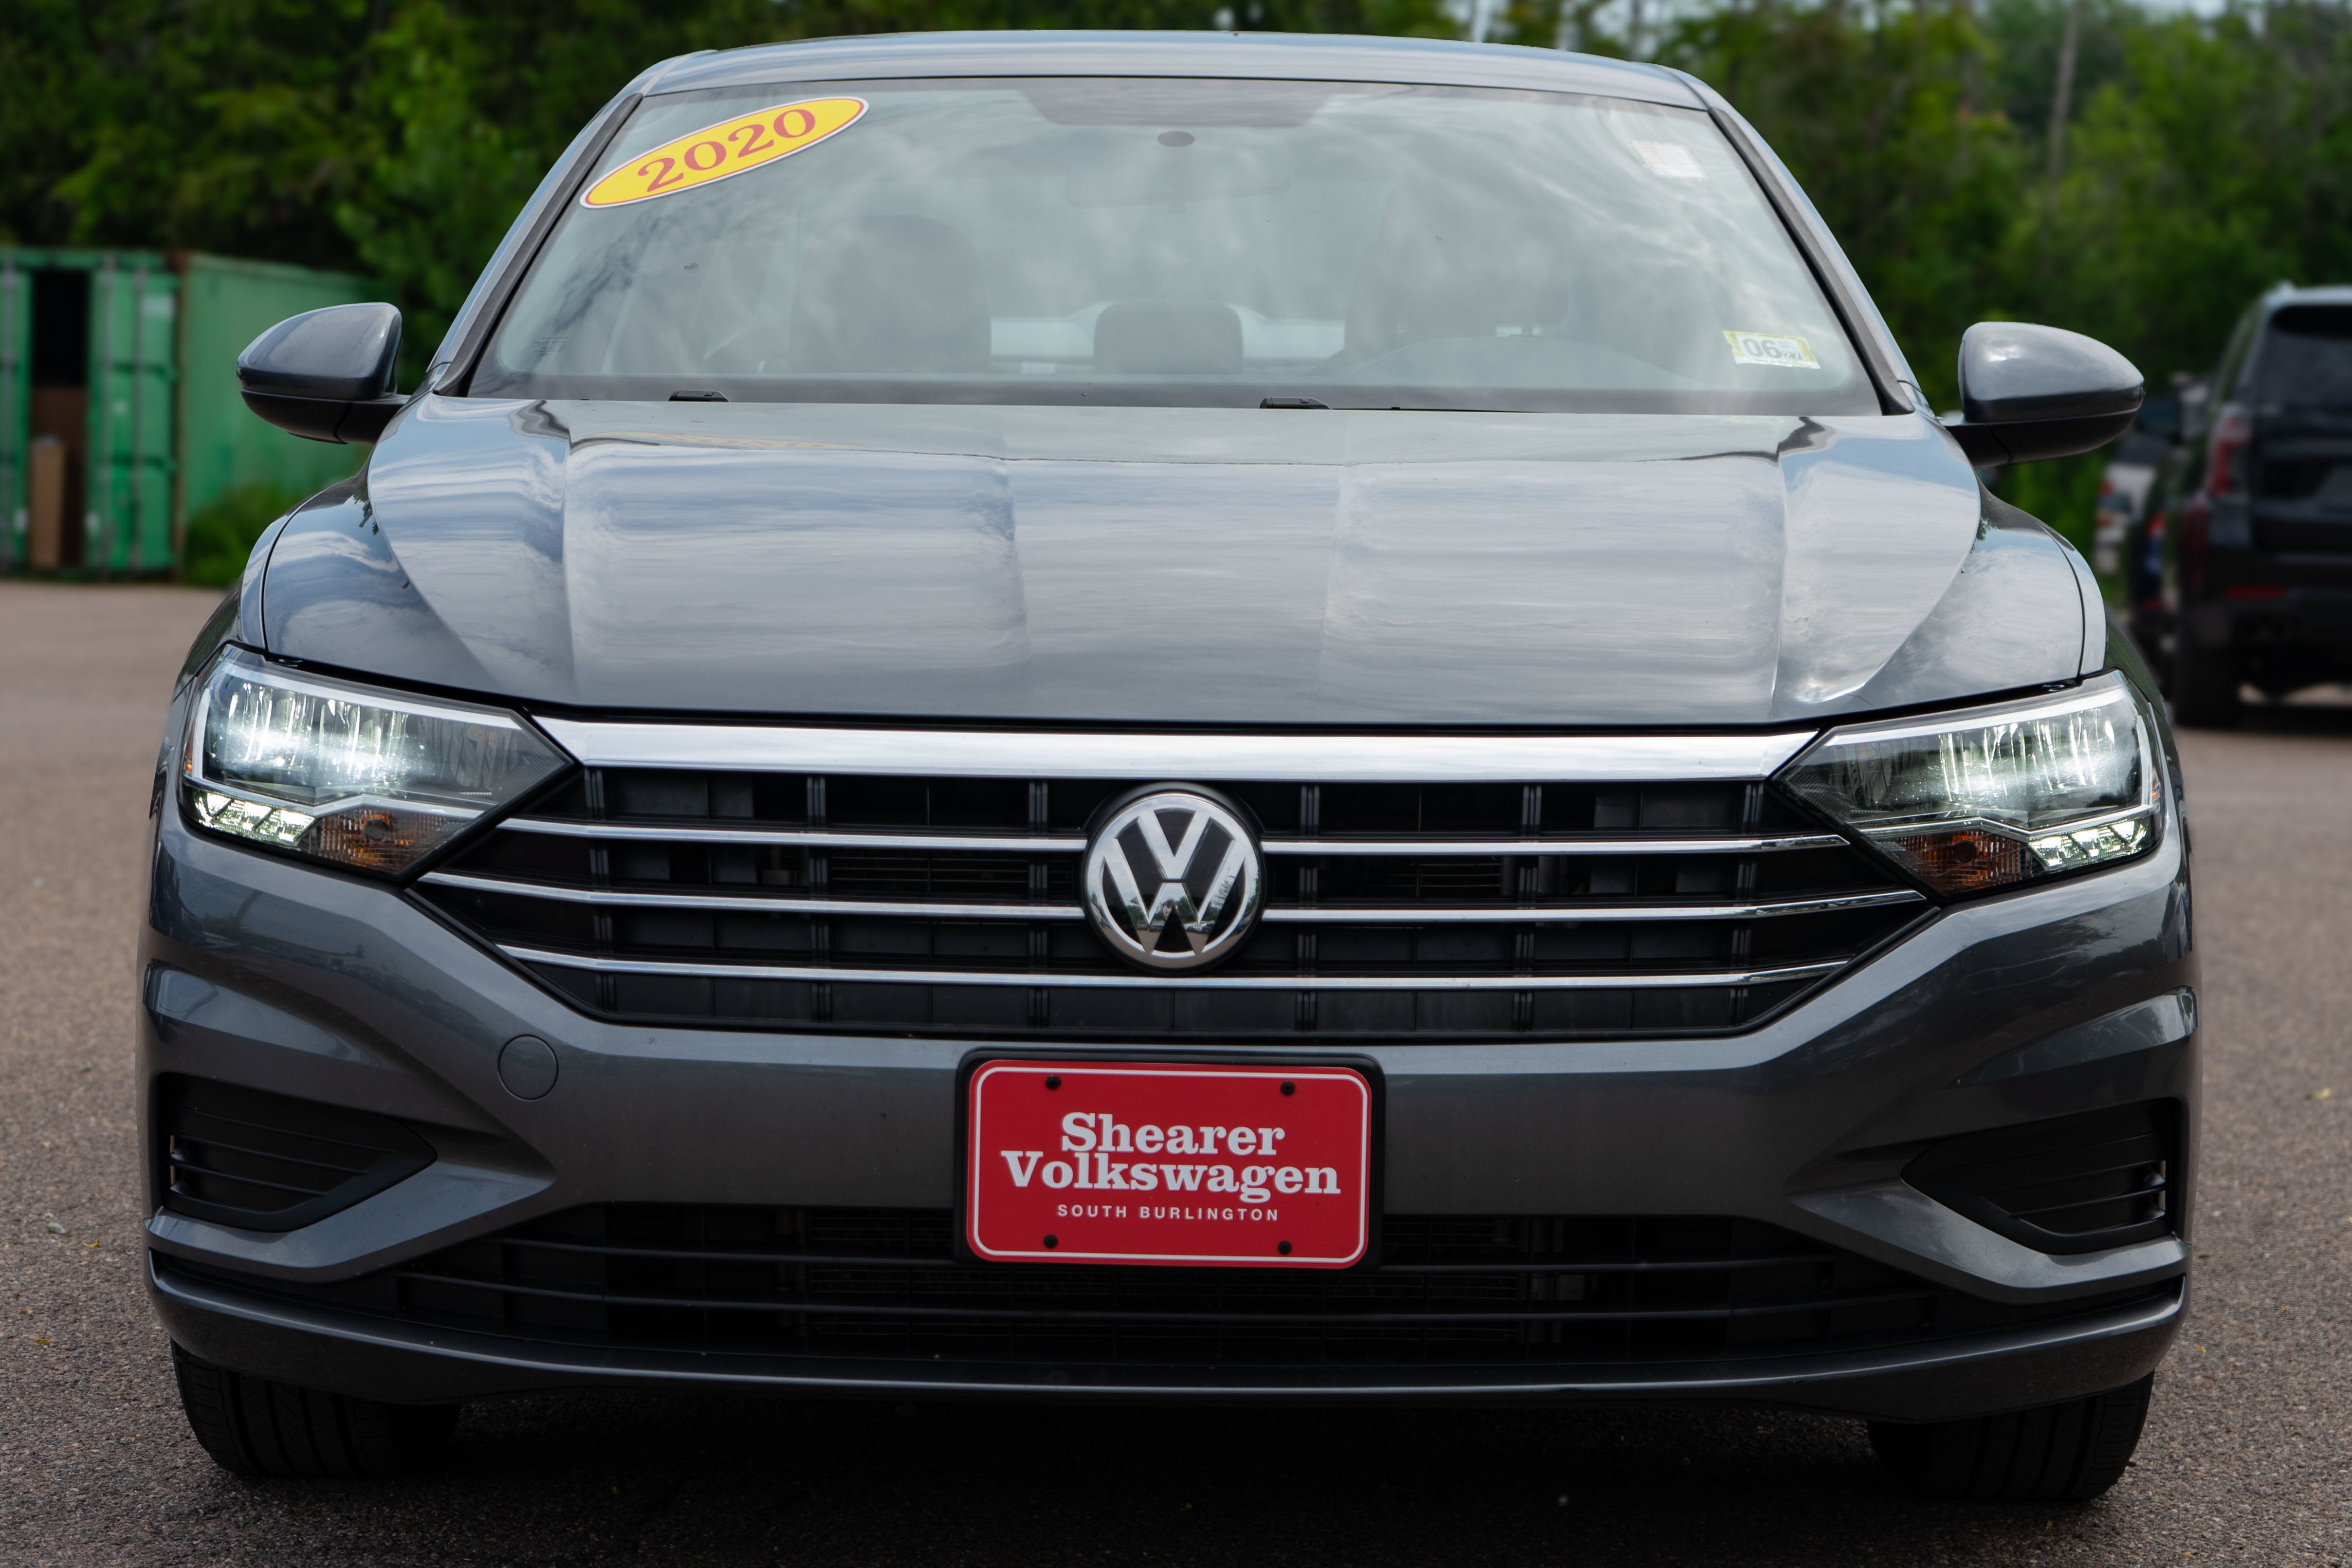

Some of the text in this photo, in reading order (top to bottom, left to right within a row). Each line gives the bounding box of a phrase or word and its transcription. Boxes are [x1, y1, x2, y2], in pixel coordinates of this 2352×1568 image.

[637, 109, 816, 193] 2020
[1742, 338, 1782, 359] 06
[1062, 1112, 1286, 1156] Shearer
[1000, 1150, 1341, 1203] Volkswagen
[1058, 1204, 1278, 1221] SOUTH BURLINGTON
